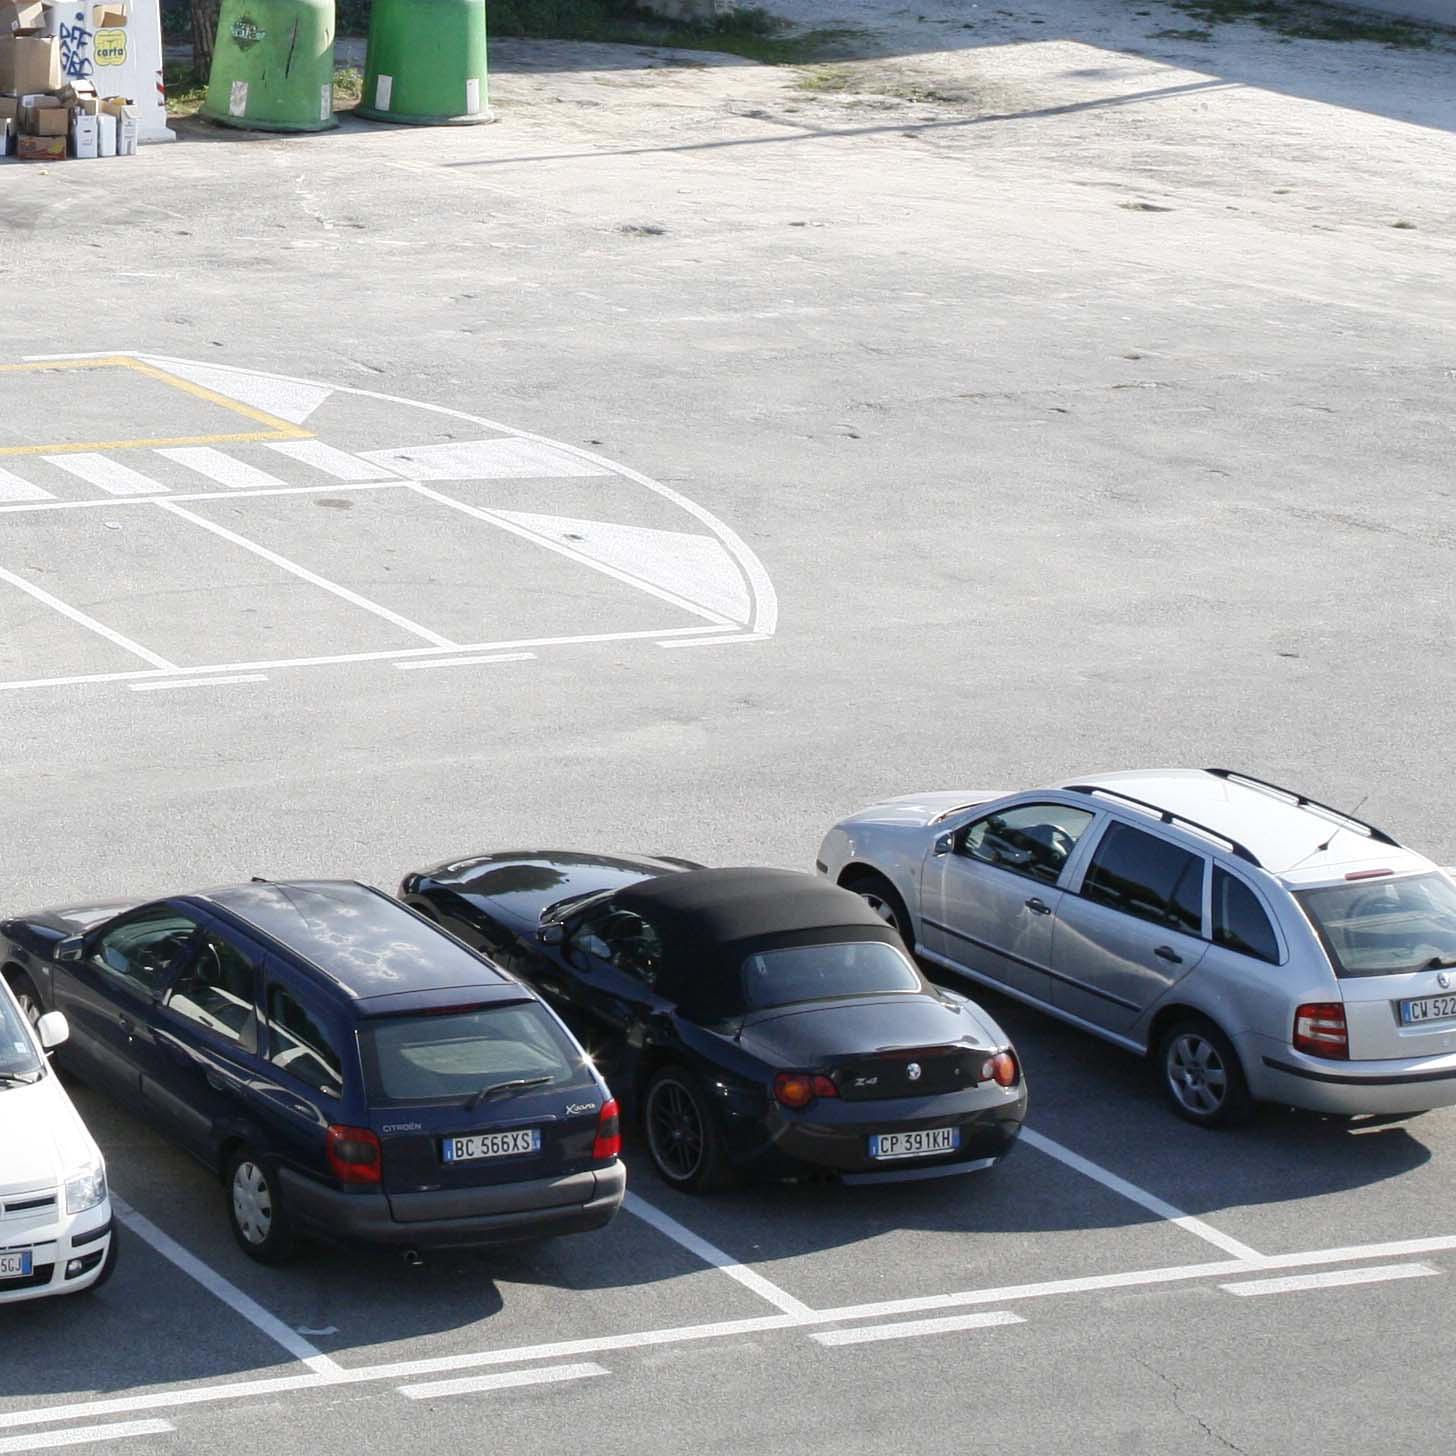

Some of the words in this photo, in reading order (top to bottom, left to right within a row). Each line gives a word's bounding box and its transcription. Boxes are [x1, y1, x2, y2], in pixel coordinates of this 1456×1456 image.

[96, 47, 124, 57] carta
[854, 1076, 878, 1087] Z4
[455, 1139, 474, 1158] BC
[481, 1132, 530, 1155] 566XS
[880, 1135, 899, 1153] CP
[904, 1129, 950, 1151] 391KH
